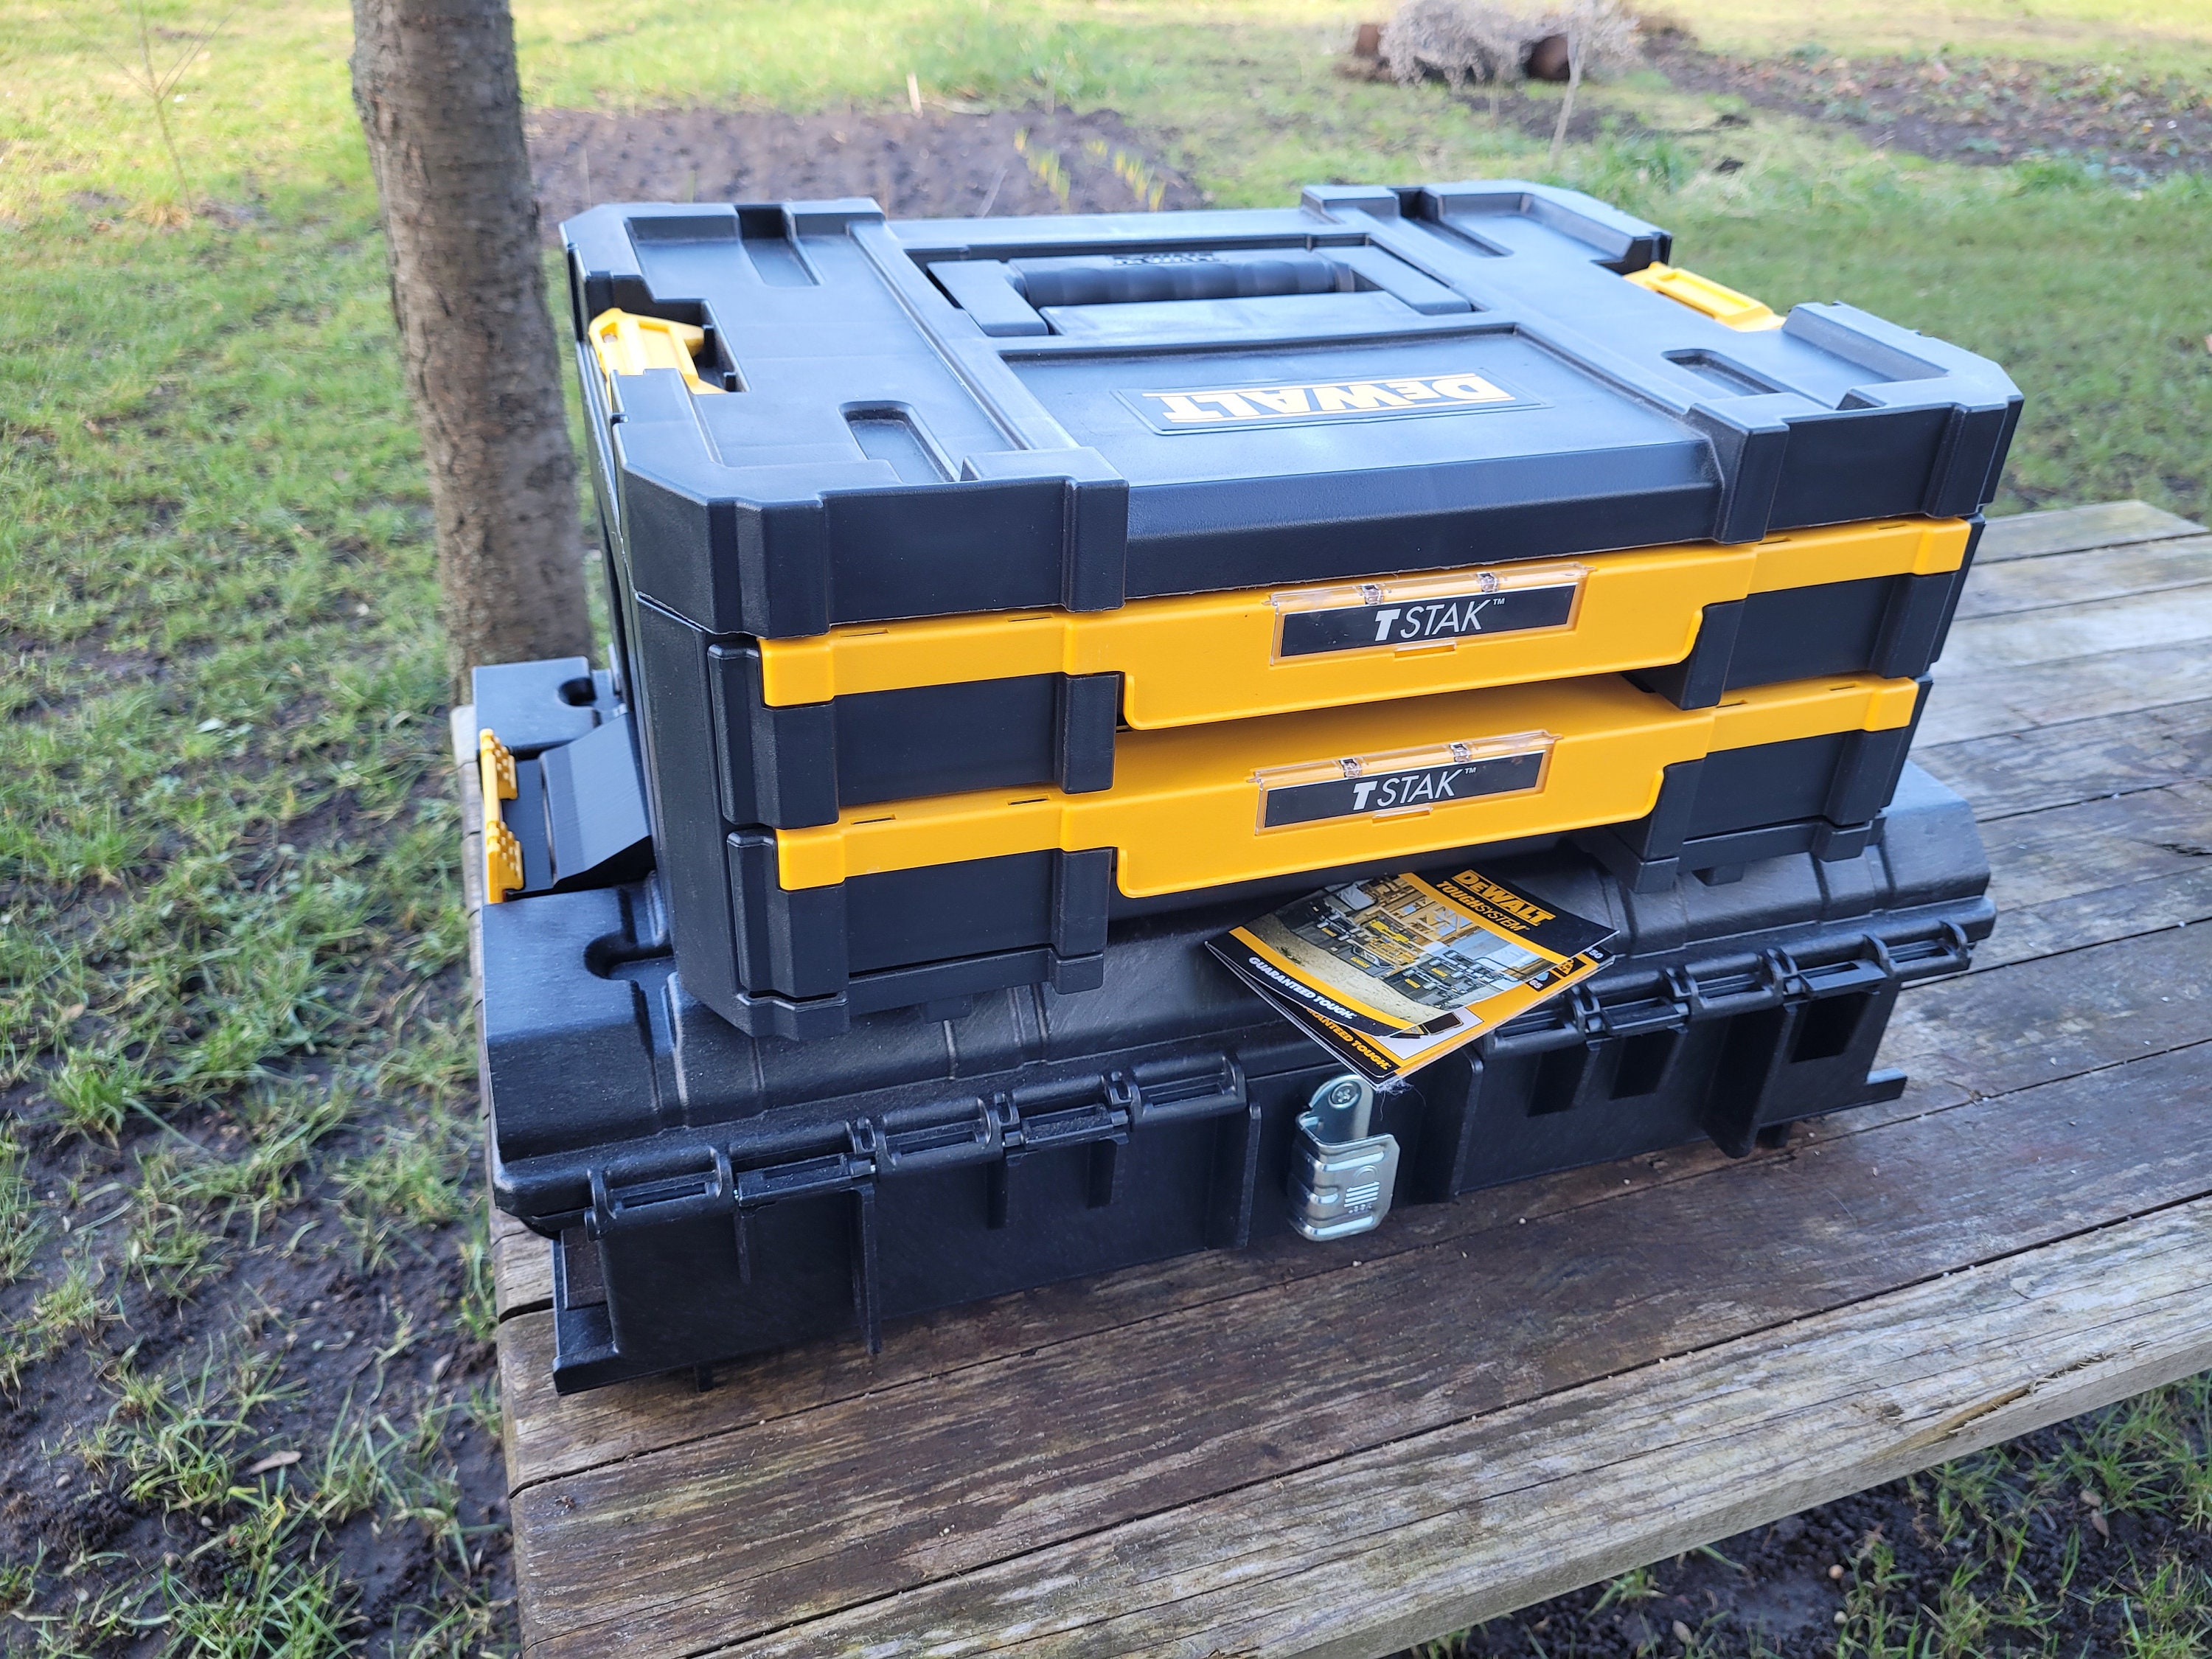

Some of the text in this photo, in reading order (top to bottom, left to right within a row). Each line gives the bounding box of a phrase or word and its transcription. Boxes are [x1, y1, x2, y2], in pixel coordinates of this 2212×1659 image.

[1141, 373, 1515, 422] DEWALT
[1451, 869, 1556, 926] DEWALT
[1248, 956, 1316, 999] GUARANTEED
